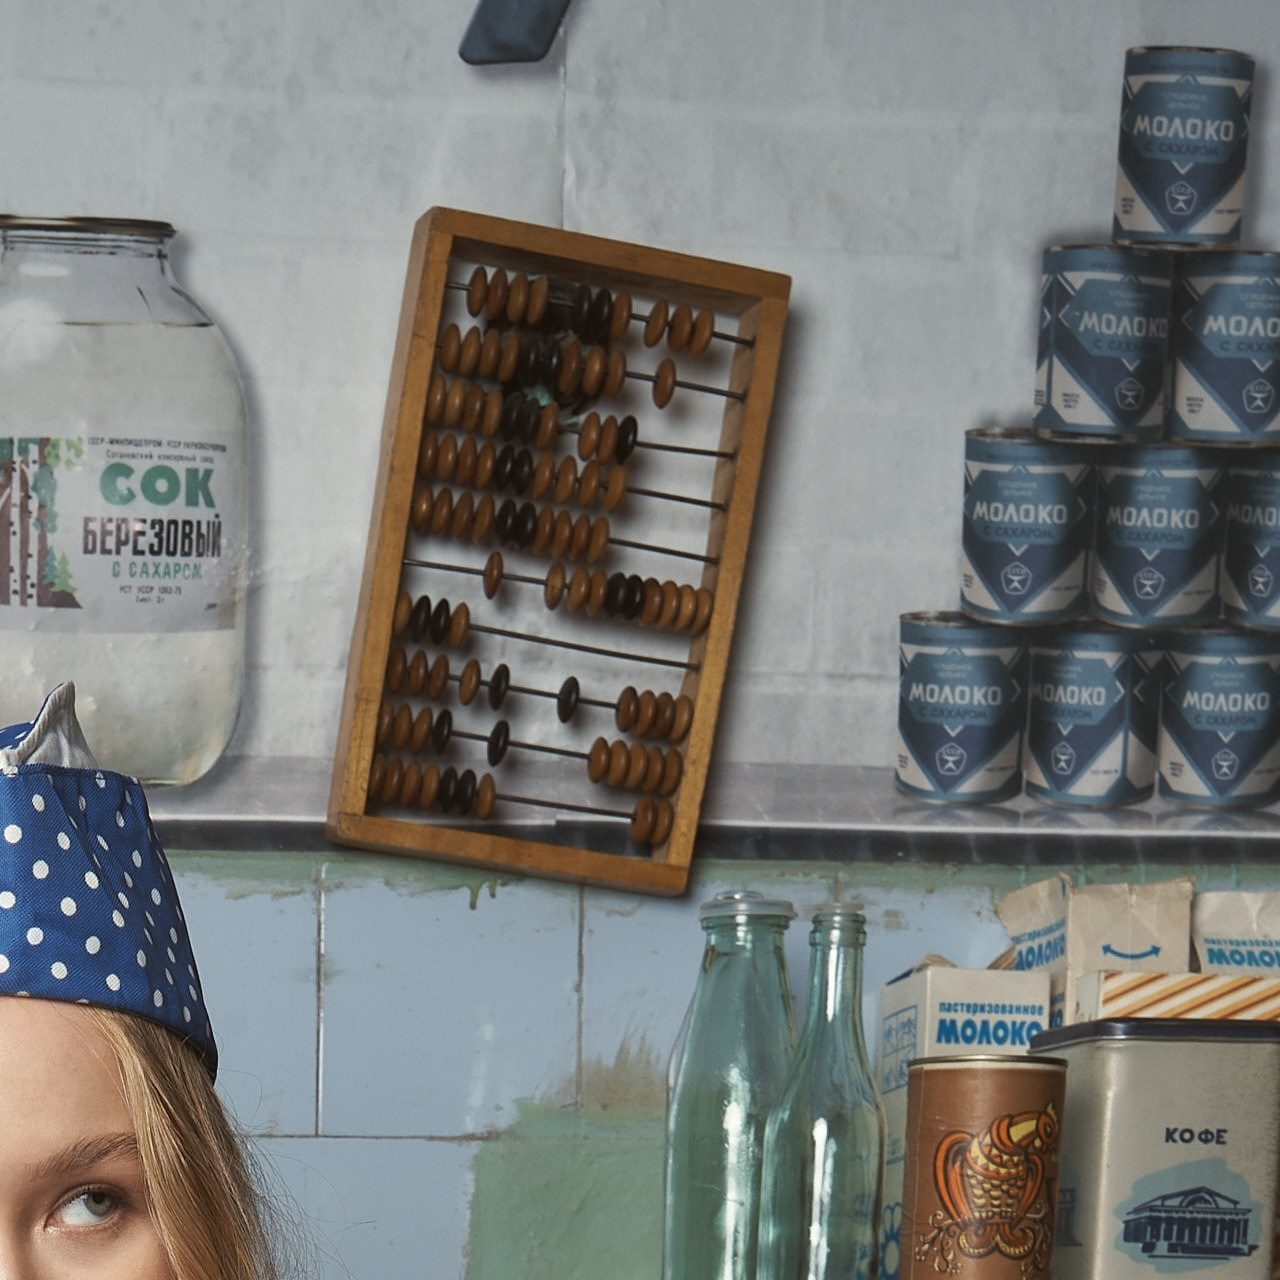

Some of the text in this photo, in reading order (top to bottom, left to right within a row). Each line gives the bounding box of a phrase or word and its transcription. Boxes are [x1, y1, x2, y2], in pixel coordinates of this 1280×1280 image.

[1133, 115, 1234, 142] МОЛОКО
[1078, 310, 1169, 339] МОЛОКО
[99, 462, 216, 508] СОК
[972, 501, 1068, 525] МОЛОКО
[1106, 505, 1201, 529] МОЛОКО
[1225, 502, 1280, 528] МОЛО
[82, 513, 223, 558] БЕРЕЗОВЫЙ
[129, 561, 202, 581] САХАРОМ
[908, 681, 1003, 706] МОЛОКО
[1028, 682, 1107, 706] МОЛОКО
[1182, 690, 1270, 713] МОЛОКО
[938, 1001, 1044, 1017] пастеризованное
[936, 1018, 1044, 1047] МОЛОКО
[1164, 1127, 1228, 1146] КОФЕ
